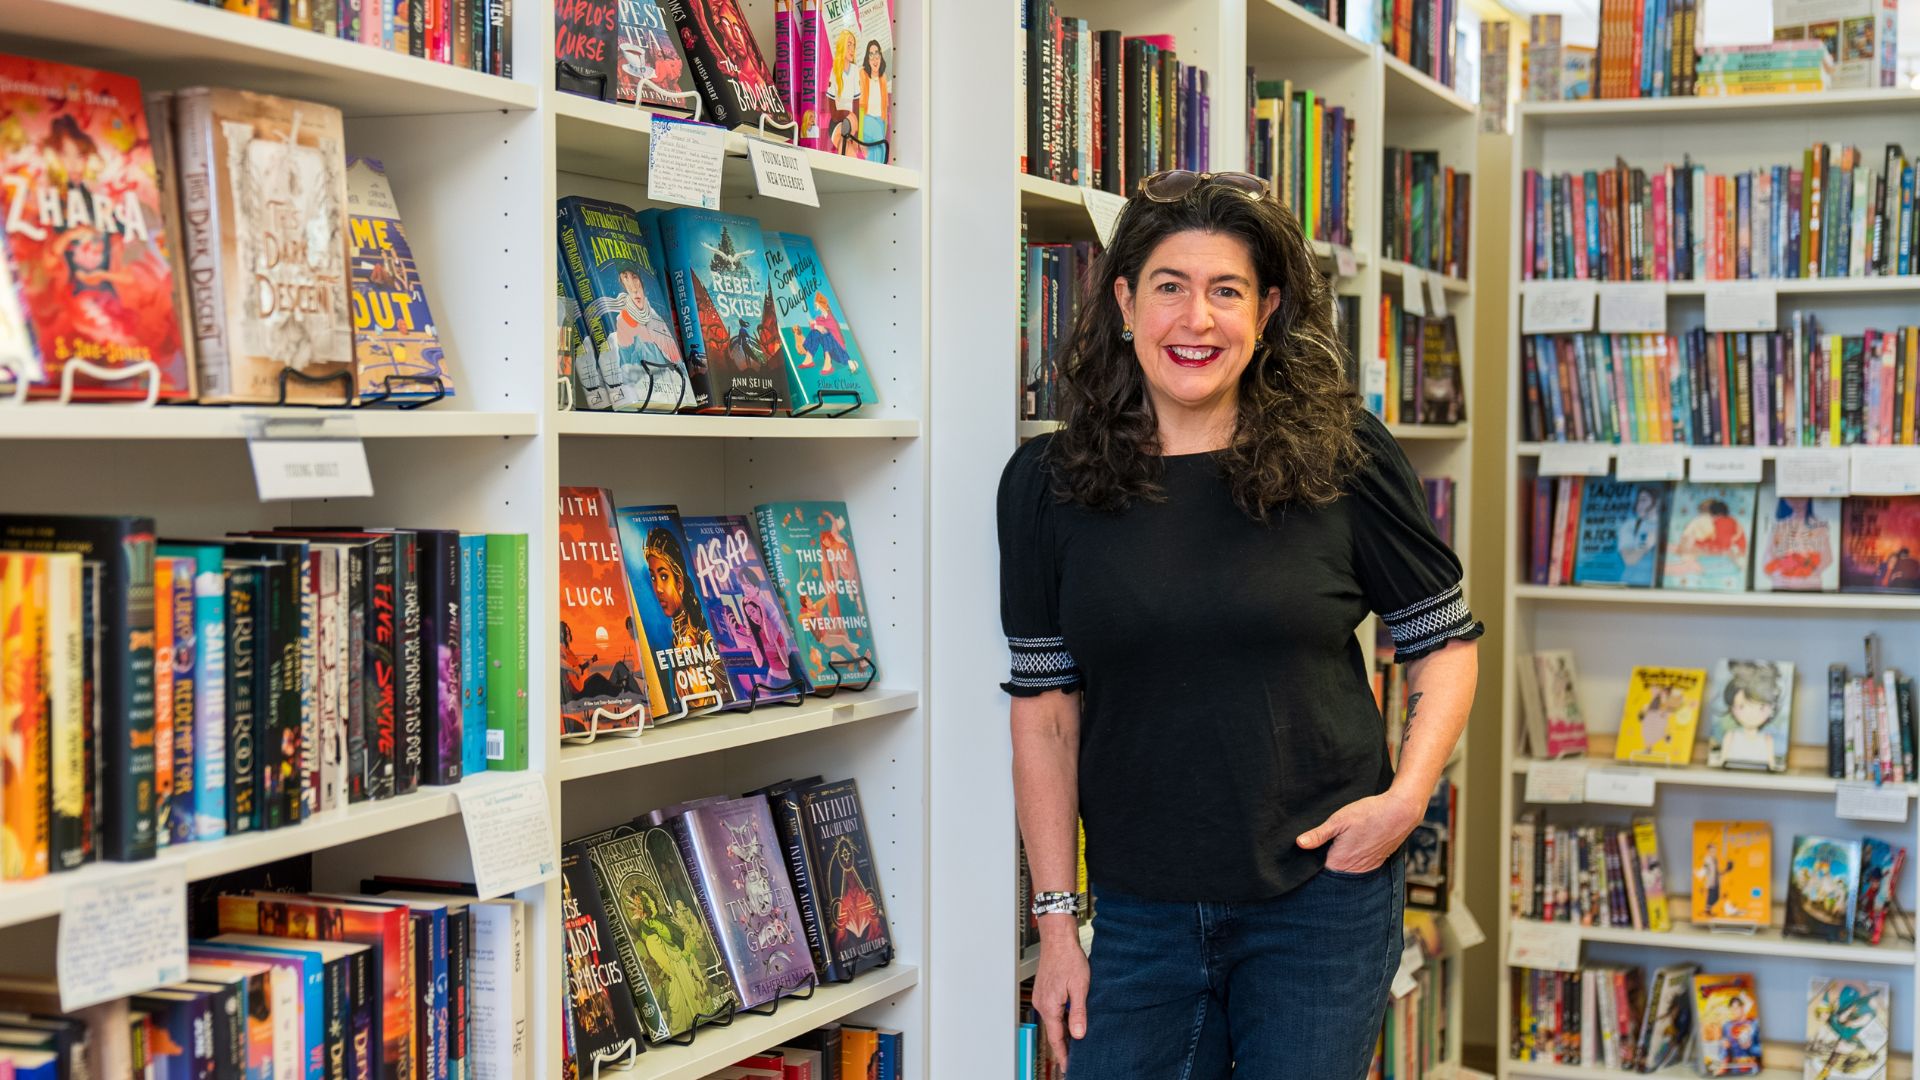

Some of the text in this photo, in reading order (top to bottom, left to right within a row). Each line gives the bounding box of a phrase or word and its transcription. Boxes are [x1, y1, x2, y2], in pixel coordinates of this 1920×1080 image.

[490, 0, 504, 27] TEN
[803, 16, 816, 38] WE
[556, 24, 605, 62] CURSE
[620, 25, 662, 51] TEA
[776, 41, 790, 64] GOT
[803, 41, 816, 64] GOT
[705, 81, 719, 101] ALBERT
[728, 79, 785, 113] BAD ONES
[1042, 39, 1051, 151] THE LAST LAUGH
[1055, 81, 1063, 128] INITIAL
[761, 150, 799, 171] YOUNG ADULT
[766, 171, 805, 191] NEW RELEASES
[3, 175, 149, 243] ZHARA
[187, 209, 213, 266] DARK
[349, 217, 393, 251] ME
[563, 228, 587, 281] SUFFRAGIST'S
[578, 277, 594, 304] GUIDE
[766, 249, 784, 271] The
[773, 253, 816, 290] Someday
[256, 273, 340, 320] DESCENT
[713, 273, 763, 297] REBEL
[777, 277, 823, 317] Daughter
[192, 267, 222, 347] DESCENT
[353, 290, 415, 330] OUT
[674, 270, 695, 340] REBEL SKIES
[716, 296, 763, 319] SKIES
[731, 377, 773, 389] ANN SEI LIN
[560, 541, 620, 562] LITTLE
[696, 529, 749, 599] ASAP
[765, 508, 786, 588] THIS DAY CHANGES
[796, 549, 848, 563] THIS DAY
[565, 586, 616, 607] LUCK
[796, 580, 858, 596] CHANGES
[463, 546, 473, 683] TOKYO EVER AFTER
[476, 594, 485, 630] EVER
[517, 544, 527, 671] TOKYO DREAMING
[802, 616, 868, 632] EVERYTHING
[373, 583, 395, 757] FIVE SURVIVE
[476, 635, 485, 680] AFTER
[656, 642, 721, 671] ETERNAL
[677, 665, 716, 690] ONES
[205, 622, 226, 789] SALT THE WATER
[231, 615, 254, 786] RUST ROOT
[173, 678, 195, 796] REDEMPTOR
[810, 794, 859, 825] INFINITY
[820, 817, 859, 840] ALCHEMIST
[563, 898, 581, 919] ESE
[789, 845, 820, 949] INFINITY ALCHEMIST
[513, 941, 521, 973] KING
[567, 920, 601, 960] ADLY
[570, 960, 623, 999] OPHECIES
[513, 1019, 526, 1058] Dig.
